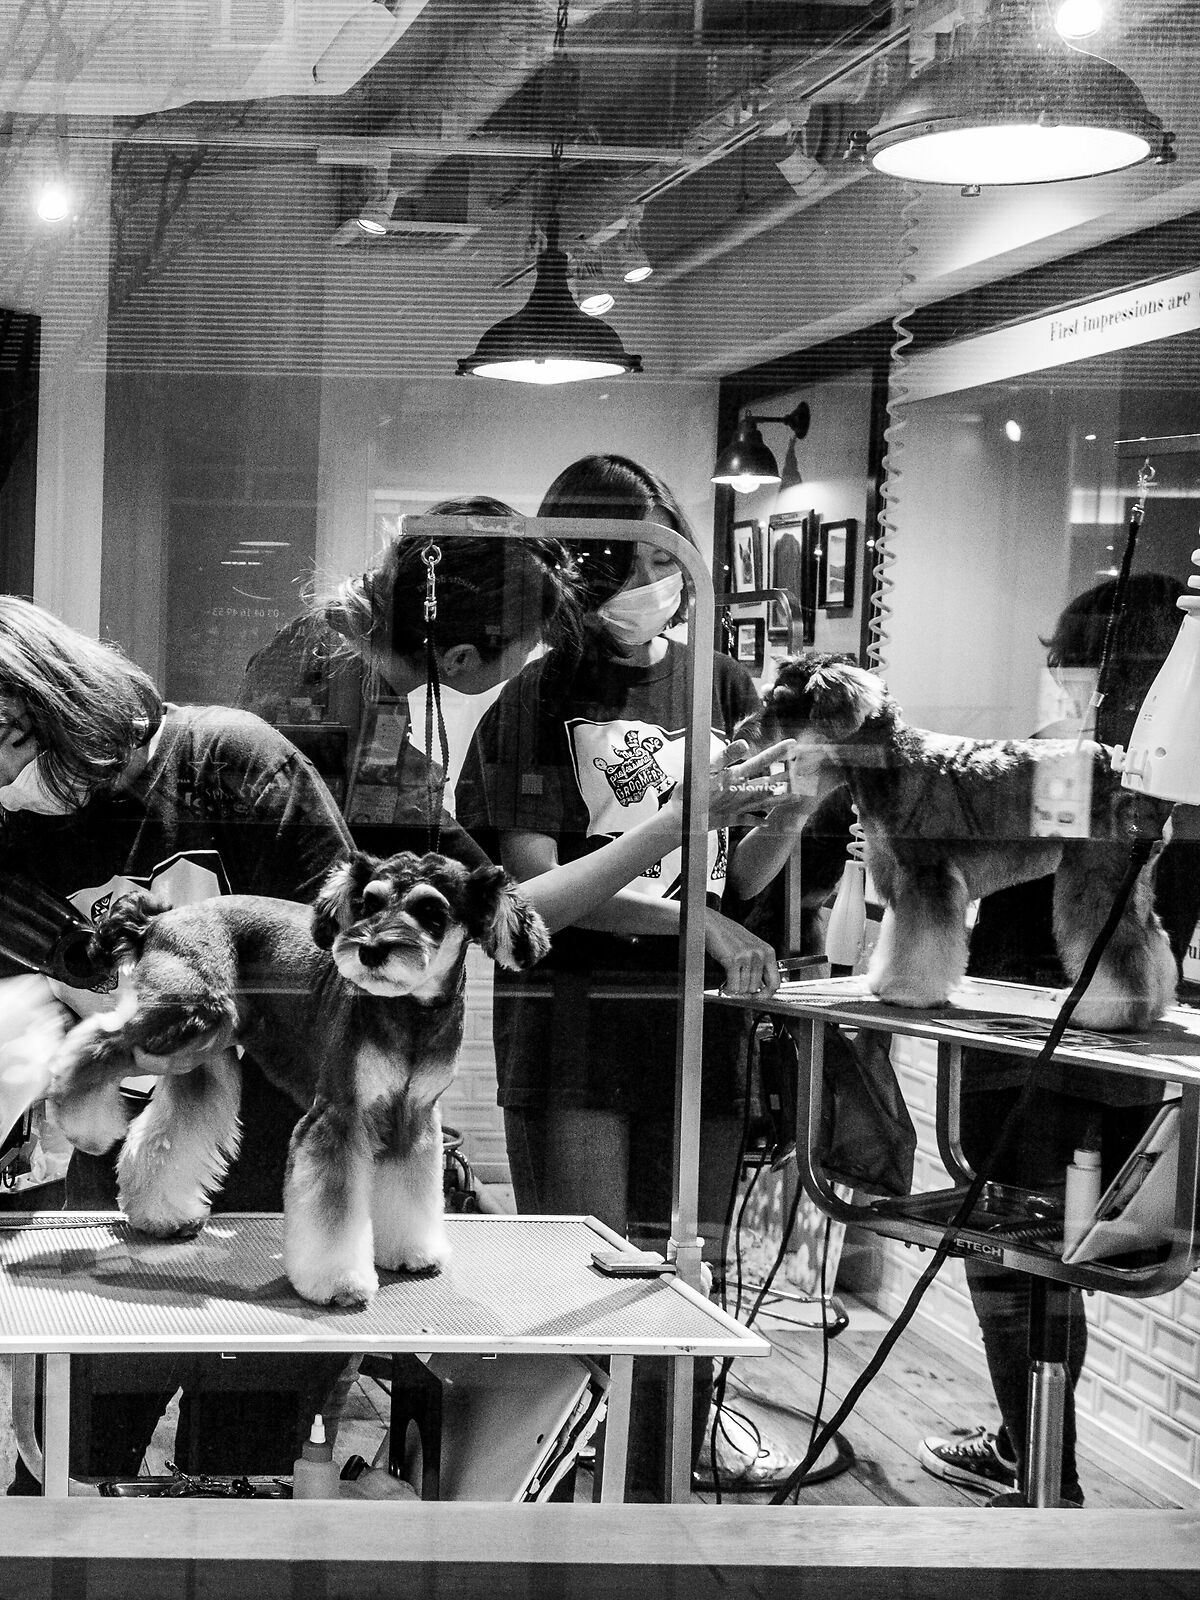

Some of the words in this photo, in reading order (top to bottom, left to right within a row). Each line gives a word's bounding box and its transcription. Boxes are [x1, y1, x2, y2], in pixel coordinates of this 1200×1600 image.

[1050, 319, 1078, 341] First
[1083, 297, 1164, 332] impressions
[1168, 291, 1191, 310] are
[616, 763, 663, 799] GROOMERS
[953, 1238, 1001, 1257] ETECH
